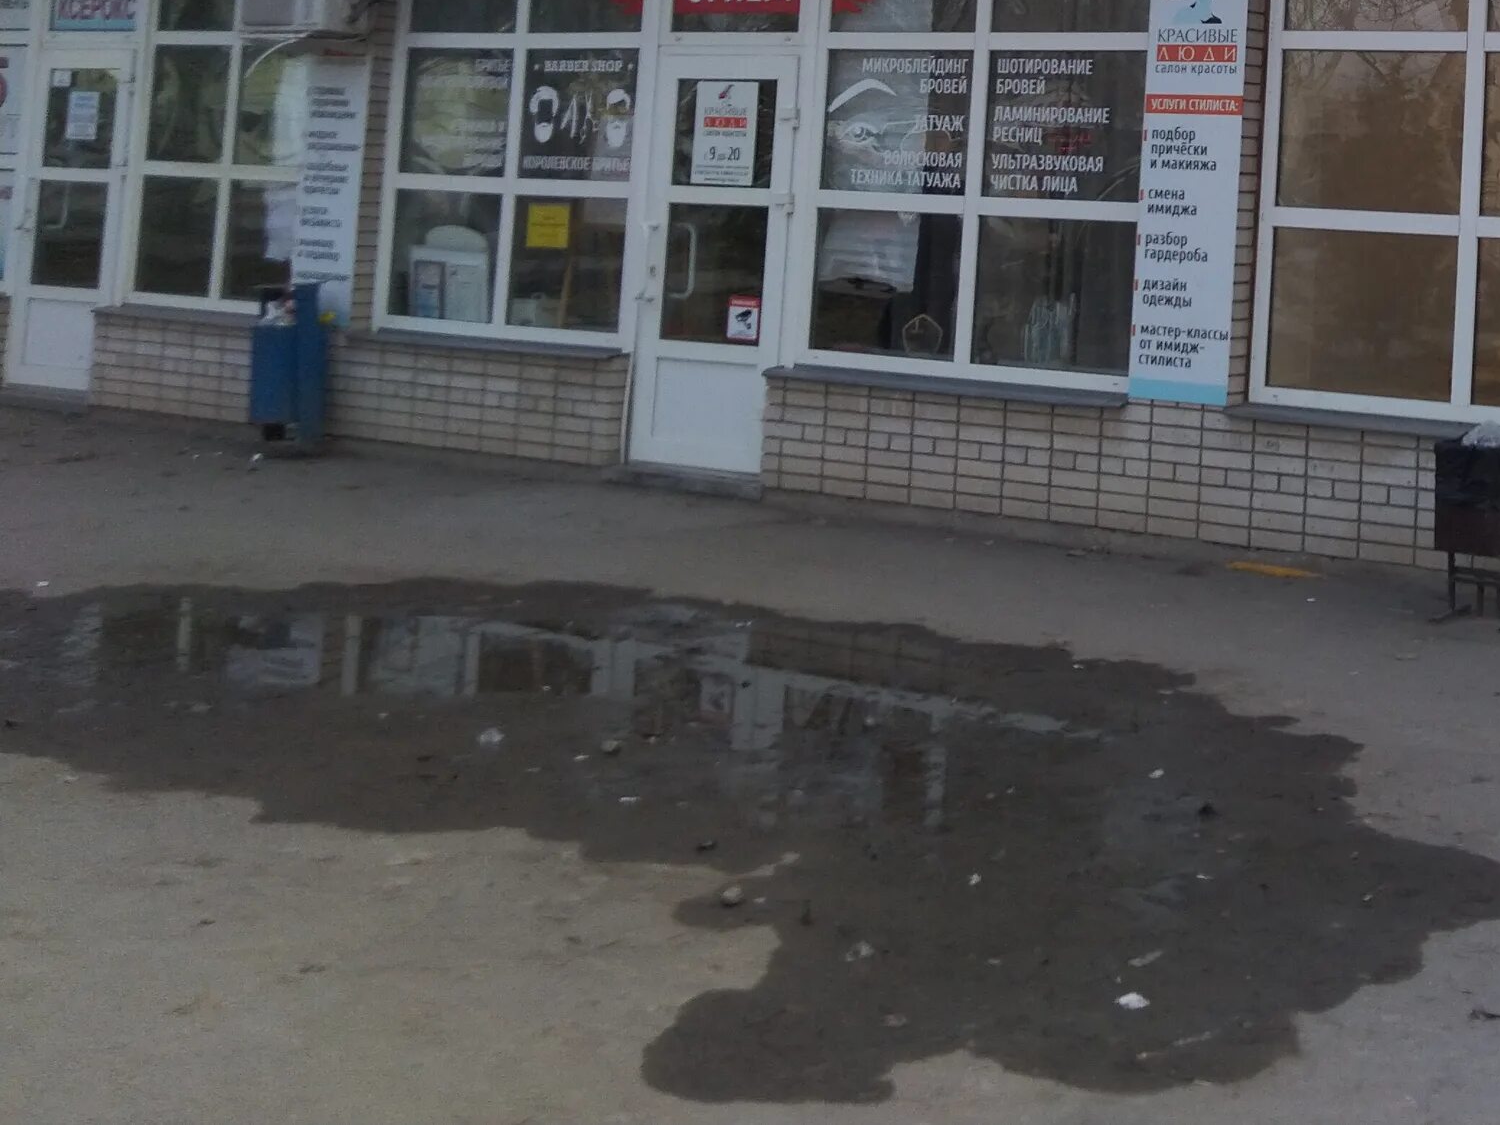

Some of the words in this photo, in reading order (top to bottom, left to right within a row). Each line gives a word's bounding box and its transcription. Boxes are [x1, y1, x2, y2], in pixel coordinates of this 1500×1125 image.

[1157, 27, 1237, 43] КРАСИВЫЕ
[1158, 46, 1237, 61] ЛЮДИ
[543, 59, 589, 72] BARBER
[591, 59, 623, 73] SHOP
[862, 55, 969, 76] МИКРОБЛЕЙДИНГ
[997, 58, 1093, 75] ШОТИРОВАНИЕ
[1155, 64, 1187, 74] салон
[1190, 64, 1237, 76] красоты
[919, 77, 968, 94] БРОВЕЙ
[996, 76, 1046, 94] БРОВЕЙ
[1151, 97, 1187, 111] УСЛУГИ
[1188, 99, 1239, 112] СТИЛИСТА:
[914, 114, 965, 132] ТАТУАЖ
[993, 106, 1111, 124] ЛАМИНИРОВАНИЕ
[992, 126, 1043, 145] РЕСНИЦ
[1151, 127, 1196, 142] подбор
[708, 146, 716, 161] 9
[727, 146, 741, 161] 20
[523, 155, 591, 171] КОРОЛЕВСКОЕ
[991, 154, 1104, 173] УЛЬТРАЗВУКОВАЯ
[1149, 159, 1157, 169] и
[1161, 159, 1217, 172] макияжа
[850, 168, 902, 185] ТЕХНИКА
[906, 171, 961, 188] ТАТУАЖА
[990, 176, 1038, 191] ЧИСТКА
[1041, 177, 1078, 195] ЛИЦА
[1148, 188, 1185, 200] смена
[1147, 203, 1198, 216] имиджа
[1145, 232, 1188, 248] разбор
[1143, 246, 1209, 263] гардероба
[1142, 278, 1187, 293] дизайн
[1142, 293, 1192, 308] одежды
[1139, 325, 1229, 341] мастер-классы
[1139, 339, 1151, 350] от
[1155, 341, 1206, 355] имидж-
[1138, 354, 1192, 369] стилиста
